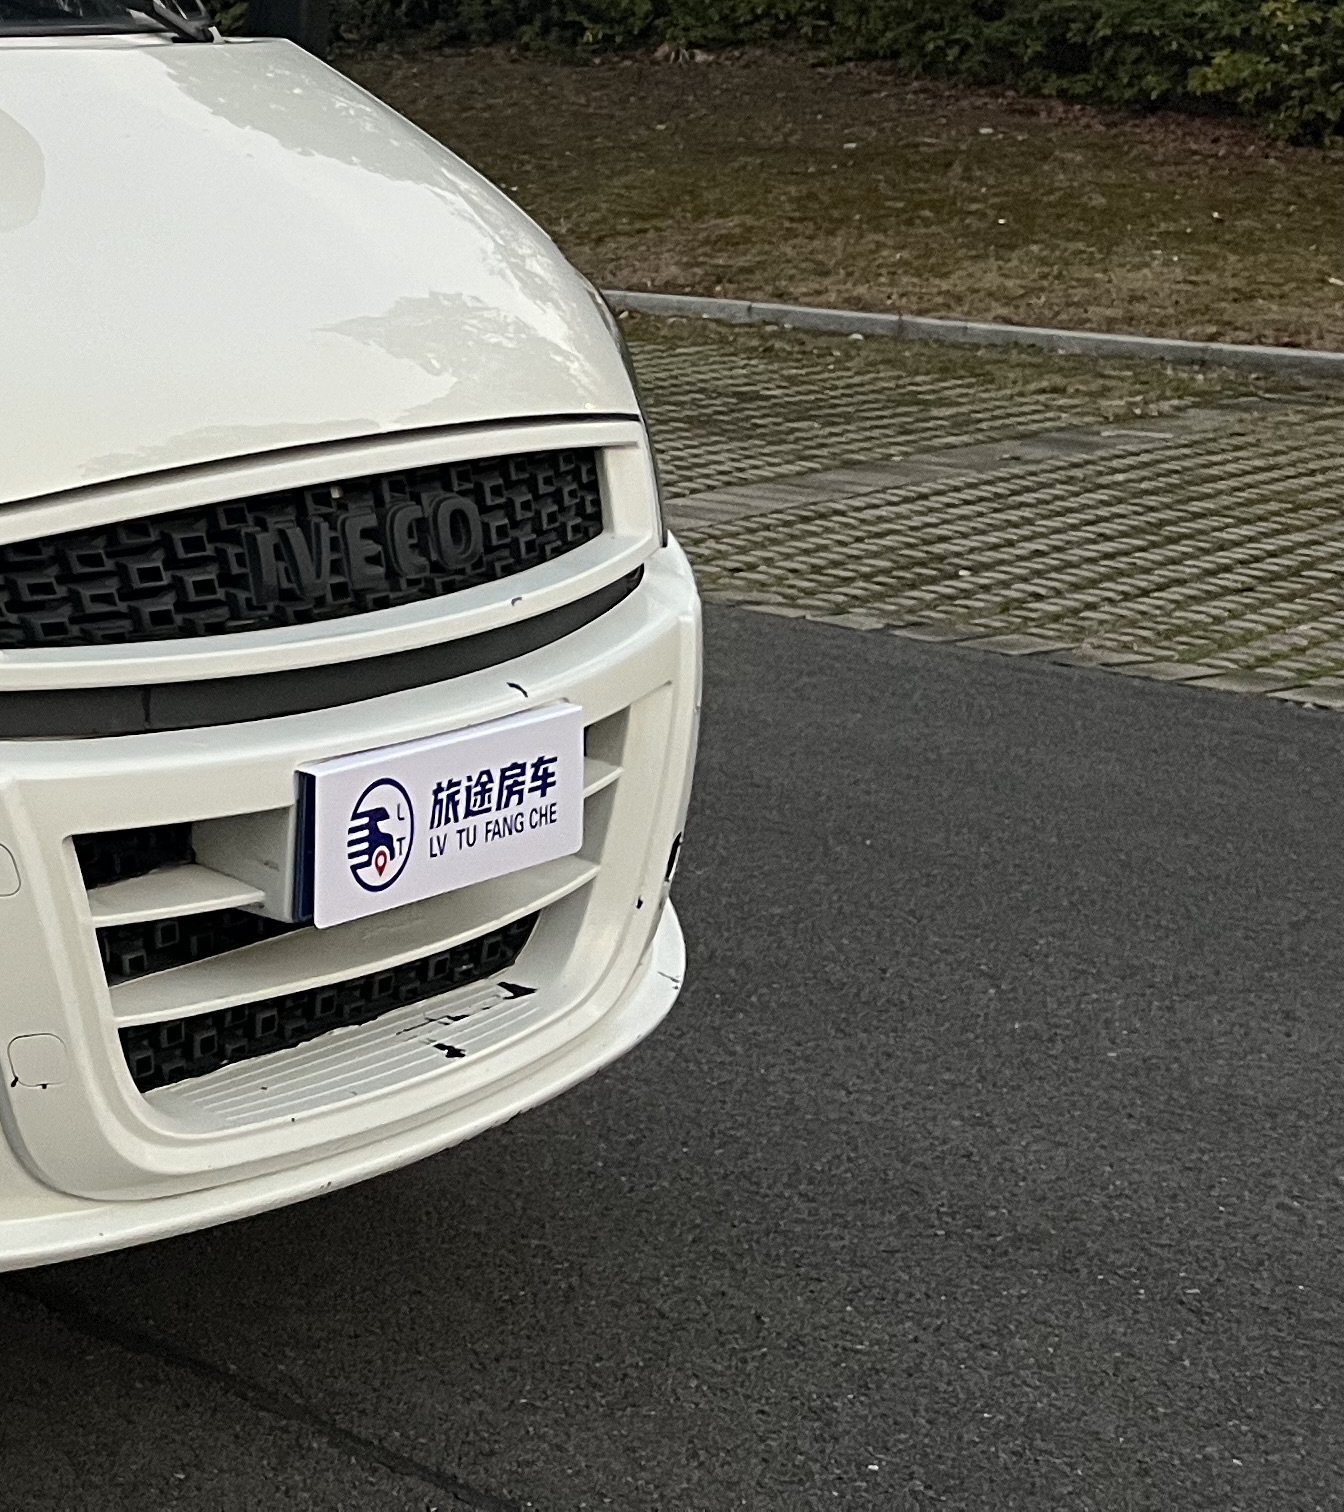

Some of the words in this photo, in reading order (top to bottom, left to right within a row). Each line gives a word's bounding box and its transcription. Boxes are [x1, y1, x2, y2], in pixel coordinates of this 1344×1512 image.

[241, 492, 485, 606] IVECO
[397, 803, 405, 821] L
[429, 755, 558, 830] 旅途房车
[396, 837, 406, 857] T
[429, 835, 447, 859] LV
[456, 824, 477, 850] TU
[484, 812, 525, 843] FANG
[529, 802, 558, 830] CHE
